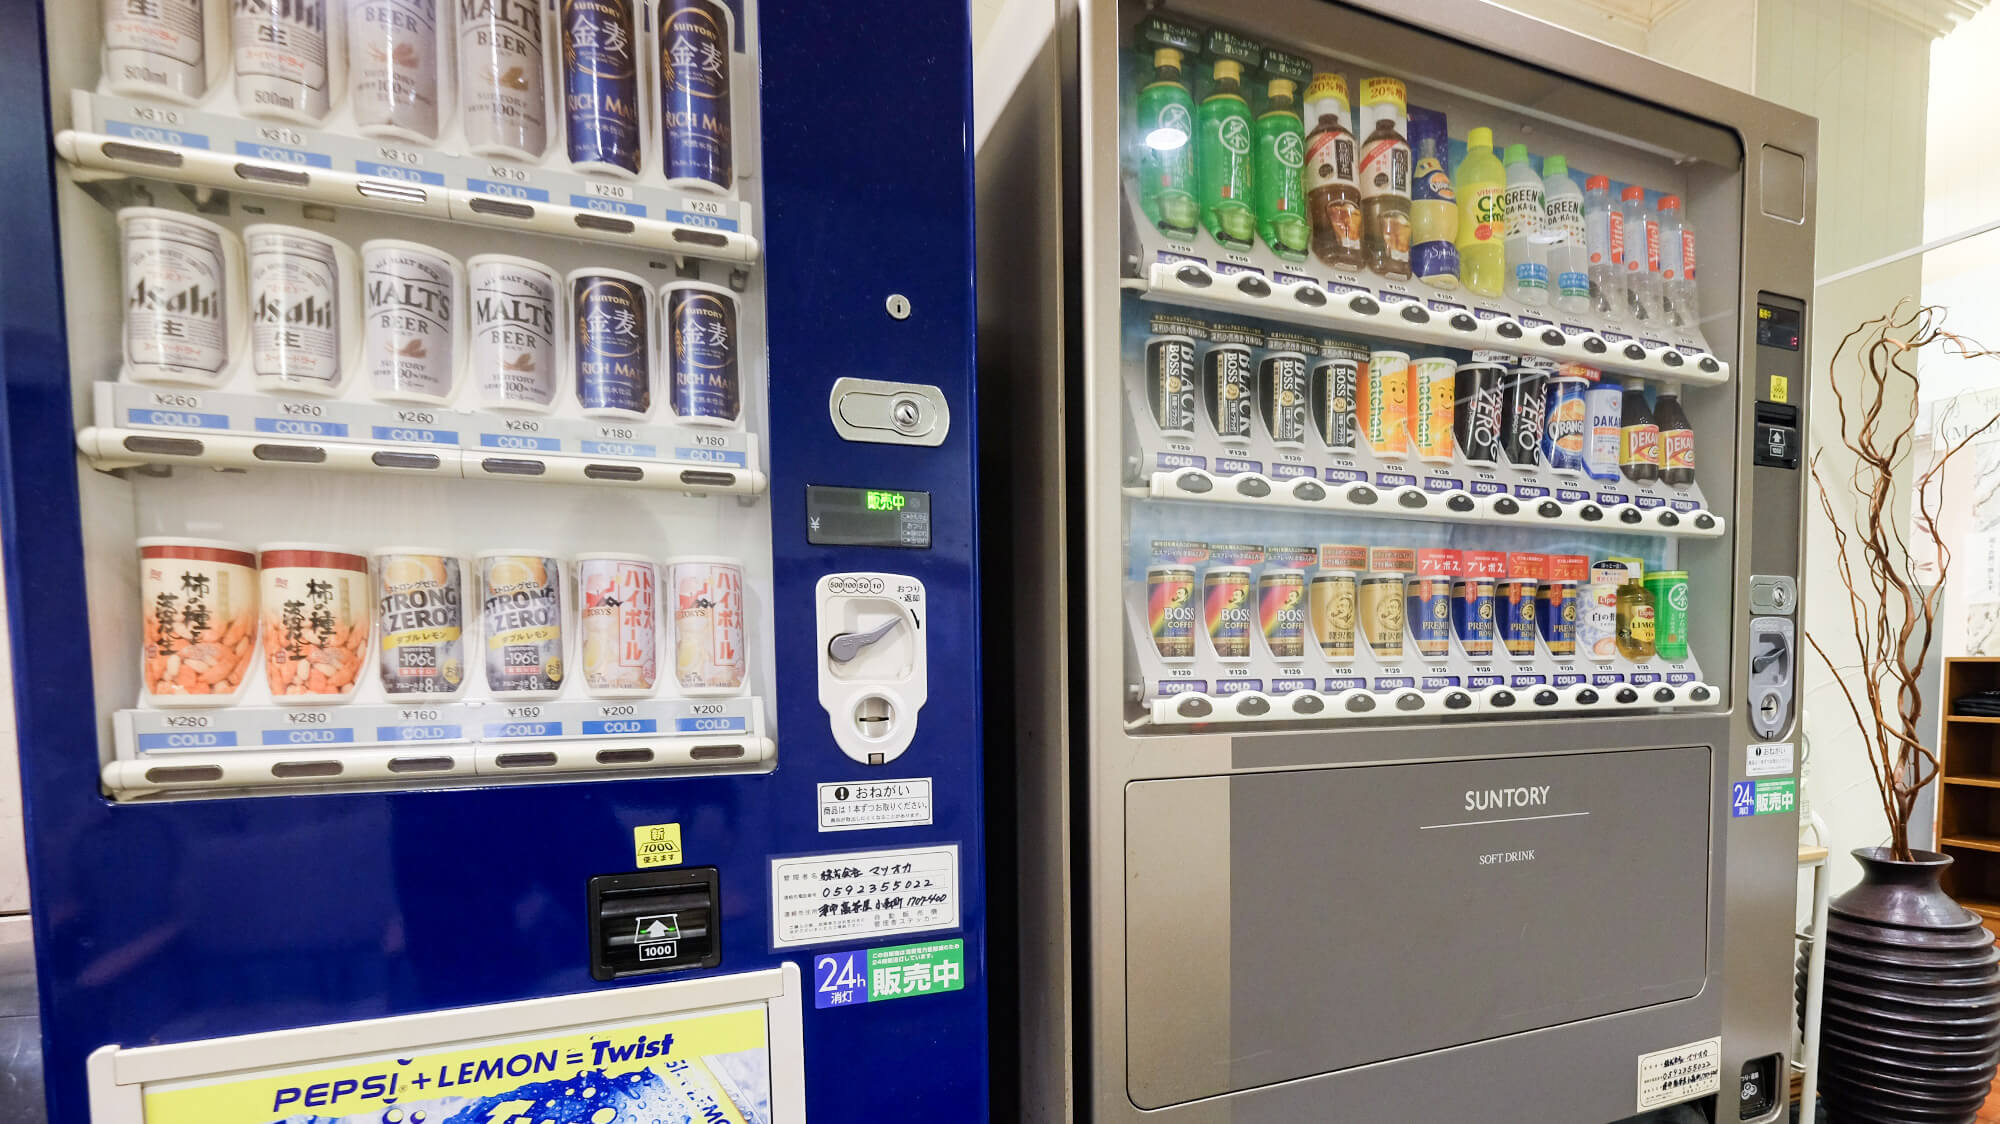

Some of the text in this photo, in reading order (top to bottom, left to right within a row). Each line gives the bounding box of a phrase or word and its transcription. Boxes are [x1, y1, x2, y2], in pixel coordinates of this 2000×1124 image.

[477, 30, 527, 57] BEER
[570, 15, 628, 59] 金麦
[669, 34, 723, 79] 金麦
[124, 65, 168, 85] 500ml
[254, 89, 295, 109] 500ml
[134, 106, 178, 124] ¥310
[260, 127, 301, 145] ¥310
[379, 147, 418, 164] ¥310
[491, 166, 525, 182] ¥310
[486, 183, 528, 200] COLD
[595, 184, 625, 197] ¥240
[1504, 188, 1538, 206] GREEN
[588, 199, 627, 213] COLD
[691, 201, 718, 214] ¥240
[1546, 200, 1579, 217] GREEN
[682, 214, 719, 230] COLD
[1608, 211, 1621, 252] Vittel
[1644, 221, 1656, 260] Vittel
[1679, 230, 1691, 267] Vittel
[130, 278, 219, 320] Asahi
[369, 280, 451, 322] MALT'S
[254, 290, 332, 330] Asahi
[477, 298, 553, 336] MALT'S
[381, 315, 429, 336] BEER
[586, 305, 639, 340] 金麦
[491, 330, 537, 350] BEER
[682, 318, 729, 352] 金麦
[582, 361, 610, 375] RICH
[677, 372, 706, 386] RICH
[1336, 367, 1346, 397] BOSS
[1169, 343, 1195, 433] BOSS BLACK
[1226, 352, 1251, 438] BOSS BLACK
[155, 393, 197, 409] ¥260
[1283, 360, 1305, 444] BOSS BLACK
[1369, 368, 1385, 448] natchan!
[282, 403, 322, 417] ¥260
[1416, 375, 1433, 451] natchan!
[1475, 387, 1496, 447] ZERO
[151, 411, 200, 428] COLD
[398, 411, 434, 425] ¥260
[1519, 391, 1539, 450] ZERO
[276, 422, 322, 436] COLD
[505, 420, 539, 433] ¥260
[601, 427, 632, 440] ¥180
[390, 429, 435, 444] COLD
[696, 434, 725, 447] ¥180
[497, 437, 538, 451] COLD
[598, 444, 634, 456] COLD
[1171, 443, 1191, 452] ¥120
[690, 450, 726, 462] COLD
[1228, 449, 1248, 457] ¥120
[1284, 454, 1302, 462] ¥120
[1164, 456, 1193, 469] COLD
[1223, 460, 1251, 472] COLD
[1336, 459, 1354, 467] ¥120
[1386, 464, 1403, 472] ¥120
[1279, 465, 1305, 476] COLD
[1332, 470, 1357, 482] COLD
[1479, 473, 1495, 481] ¥120
[1382, 474, 1406, 486] COLD
[1430, 479, 1453, 490] COLD
[1476, 483, 1498, 494] COLD
[1520, 486, 1541, 497] COLD
[1561, 490, 1582, 501] COLD
[867, 490, 905, 512] 販売中
[1601, 494, 1621, 504] COLD
[1639, 497, 1658, 508] COLD
[1674, 501, 1693, 511] COLD
[810, 516, 820, 532] ¥
[830, 581, 843, 589] 500
[845, 581, 857, 589] 100
[897, 585, 920, 593] おつり
[380, 587, 457, 617] STRONG
[485, 586, 556, 616] STRONG
[389, 607, 449, 633] ZERO
[494, 607, 549, 633] ZERO
[624, 570, 643, 660] ハイボール
[717, 572, 735, 660] ハイボール
[1164, 607, 1195, 622] BOSS
[1220, 608, 1250, 622] BOSS
[1171, 669, 1191, 677] ¥120
[1557, 675, 1577, 685] COLD
[1596, 674, 1616, 685] COLD
[1634, 673, 1653, 683] COLD
[1670, 673, 1688, 682] COLD
[1166, 682, 1194, 694] COLD
[1223, 681, 1251, 693] COLD
[1279, 681, 1304, 692] COLD
[1331, 680, 1355, 690] COLD
[1380, 679, 1403, 689] COLD
[1427, 678, 1449, 688] COLD
[1473, 678, 1494, 688] COLD
[1516, 676, 1536, 686] COLD
[402, 710, 438, 722] ¥160
[507, 706, 540, 718] ¥160
[602, 706, 634, 716] ¥200
[694, 704, 723, 715] ¥200
[167, 715, 207, 728] ¥280
[288, 712, 327, 724] ¥280
[695, 718, 730, 731] COLD
[401, 726, 444, 740] COLD
[505, 724, 545, 736] COLD
[604, 721, 640, 733] COLD
[168, 733, 217, 747] COLD
[289, 729, 335, 744] COLD
[855, 785, 910, 800] おねがい
[1464, 785, 1551, 811] SUNTORY
[650, 827, 665, 842] 新
[644, 842, 673, 853] 1000
[643, 854, 675, 864] 使えます
[1479, 849, 1536, 866] SOFT DRINK
[823, 879, 933, 898] 0592355022
[645, 945, 672, 957] 1000
[818, 953, 866, 993] 24h
[873, 959, 960, 998] 販売中
[831, 990, 854, 1005] 消灯
[273, 1072, 399, 1113] PEPSI
[438, 1049, 558, 1088] LEMON
[591, 1033, 674, 1066] Twist
